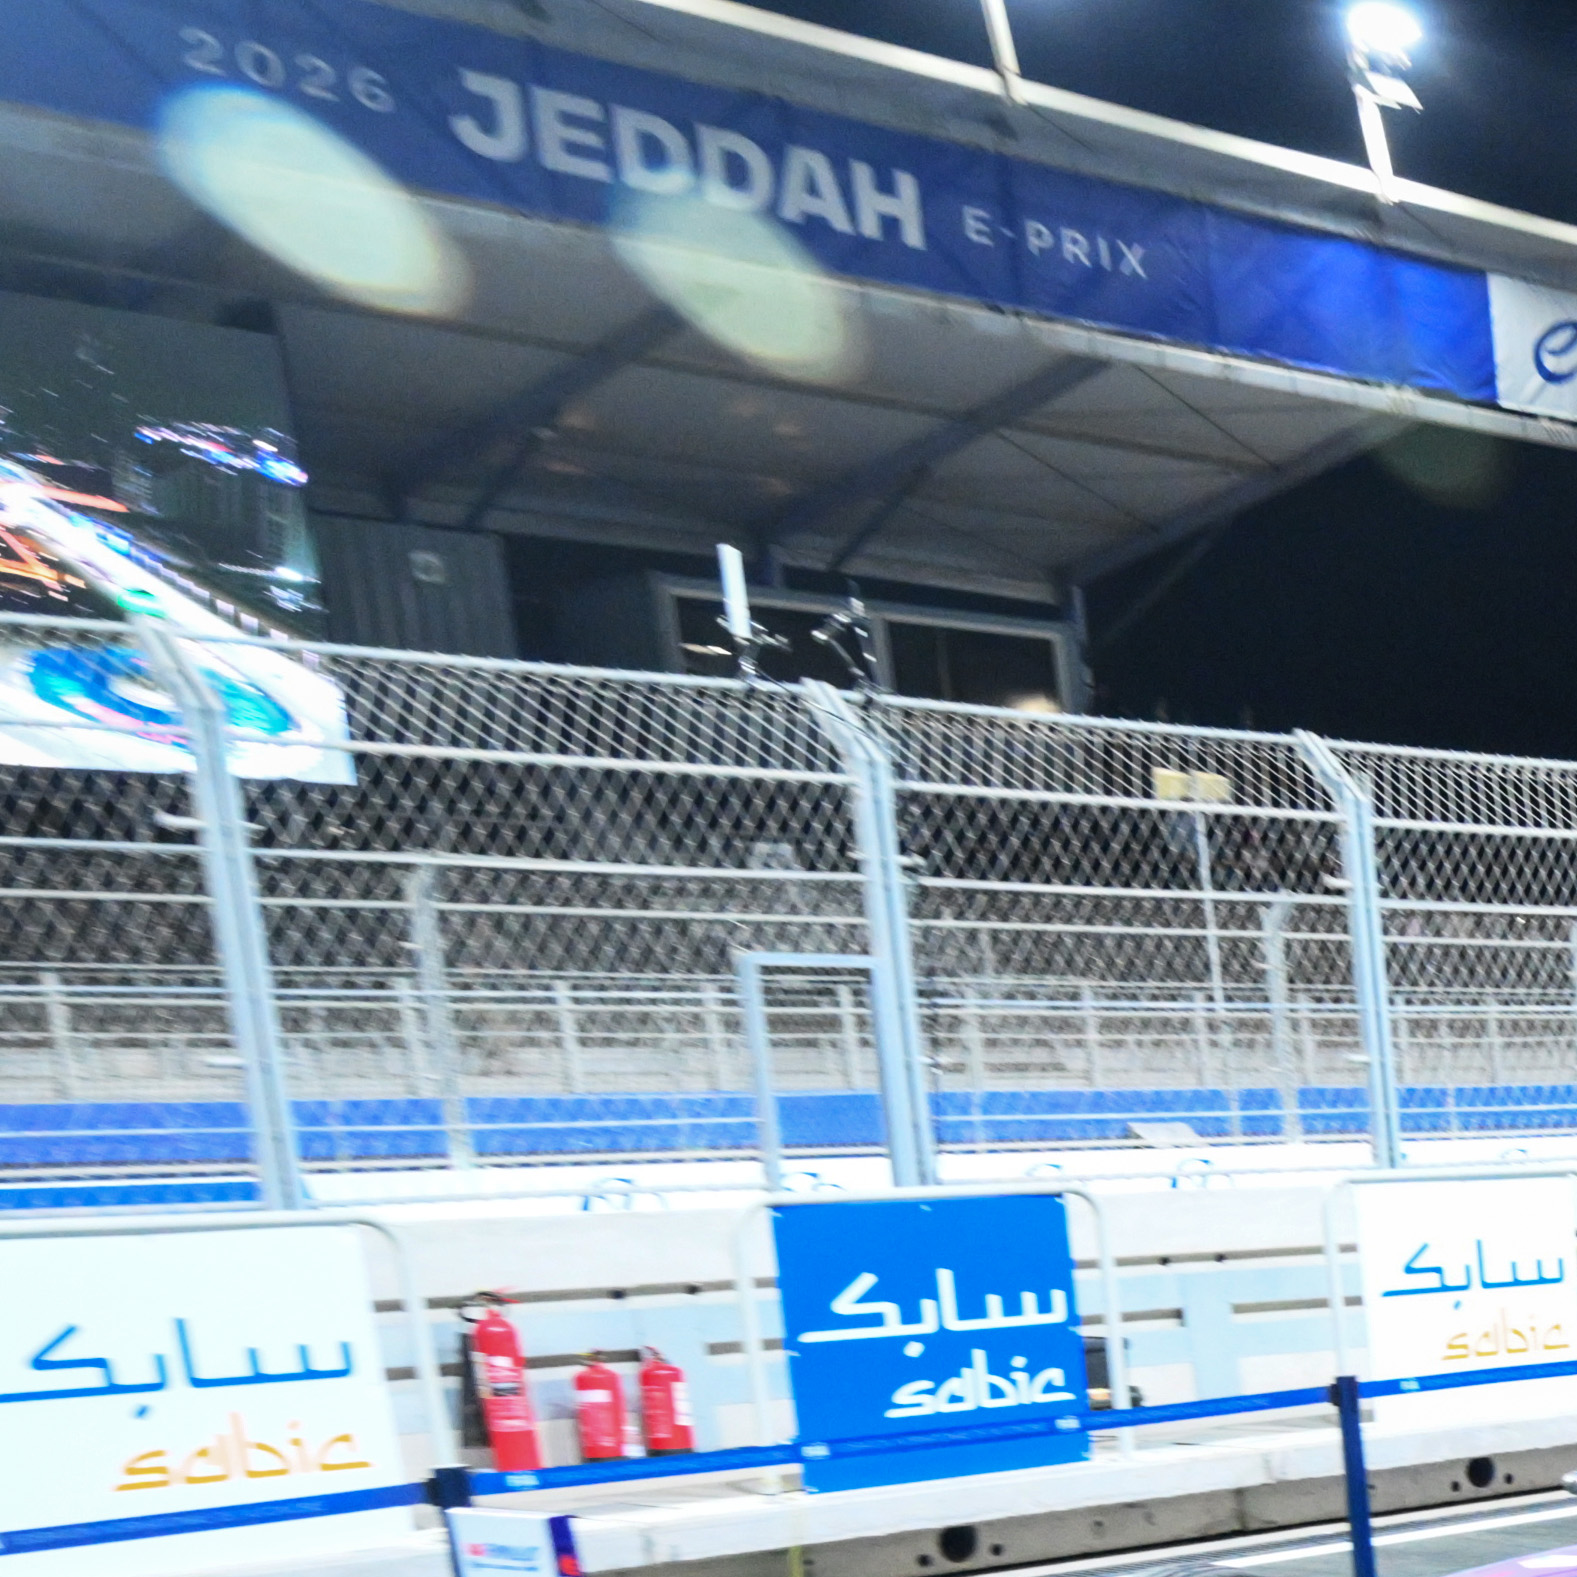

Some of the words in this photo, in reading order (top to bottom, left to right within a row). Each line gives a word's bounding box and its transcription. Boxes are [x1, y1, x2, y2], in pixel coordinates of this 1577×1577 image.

[179, 27, 396, 113] 2026
[448, 67, 927, 250] JEDDAH
[961, 205, 1150, 280] E-PRIX
[796, 1267, 1069, 1359] سابك
[1380, 1238, 1567, 1311] سابك
[0, 1316, 353, 1419] سابك
[1440, 1305, 1572, 1362] sabic
[883, 1348, 1078, 1419] sabic
[110, 1409, 374, 1493] sabic
